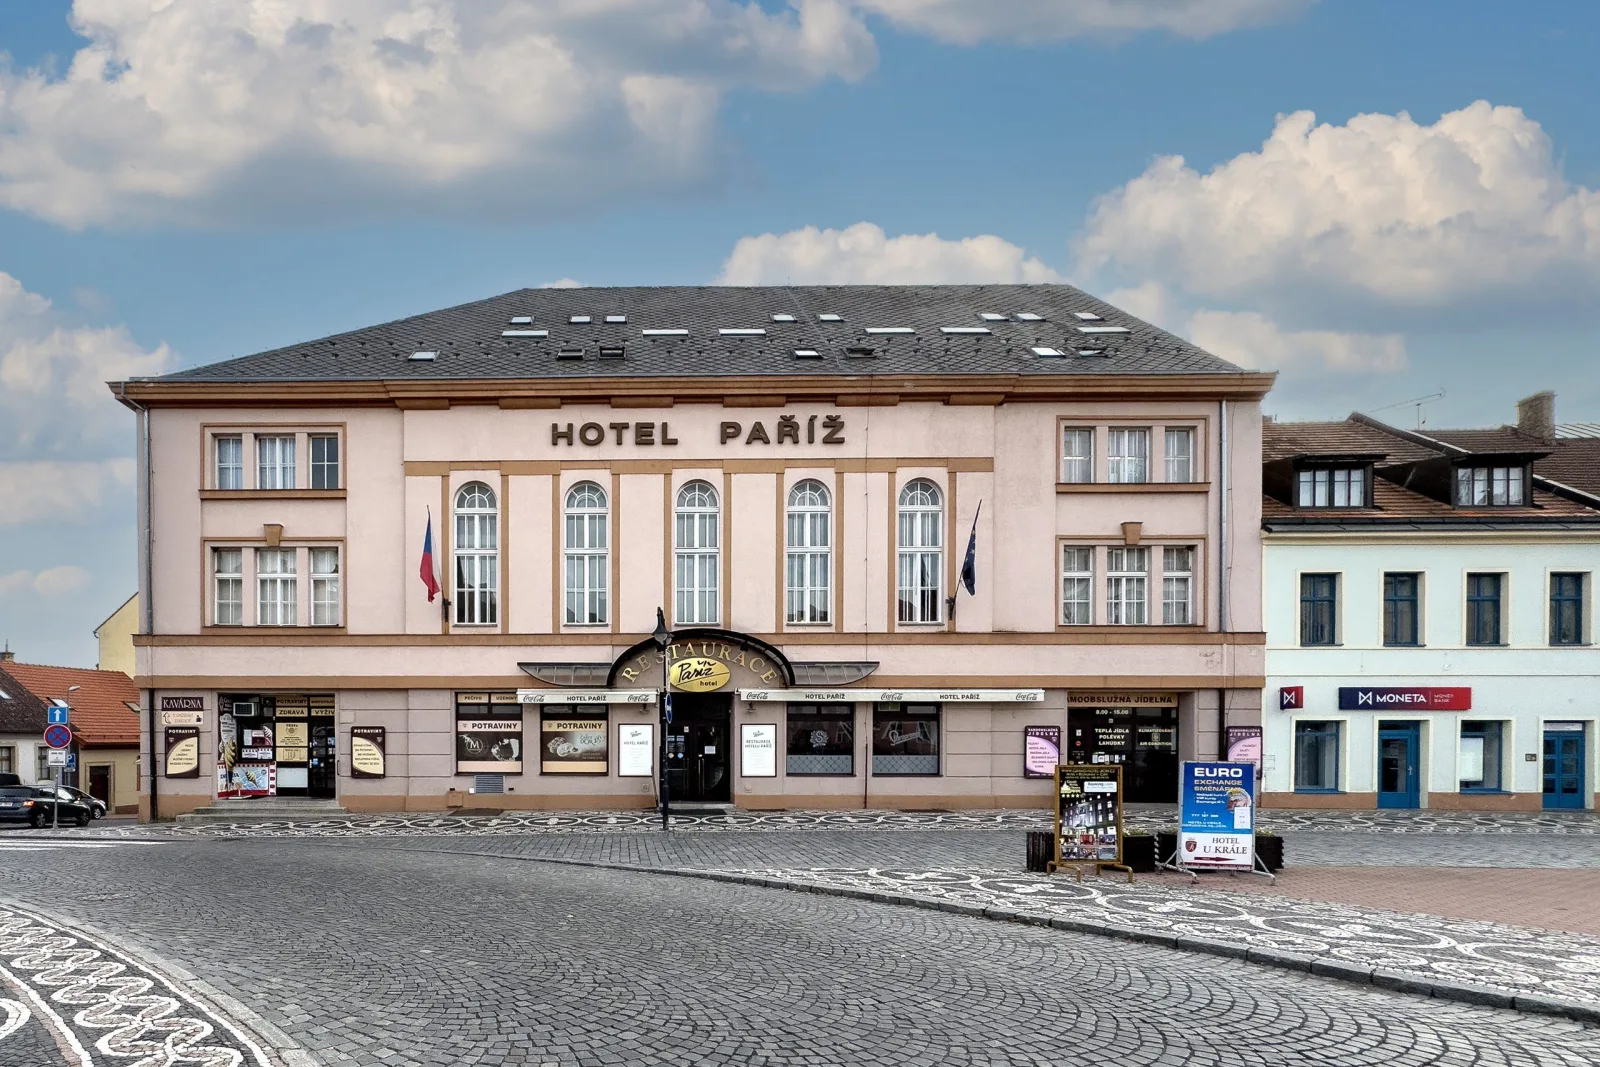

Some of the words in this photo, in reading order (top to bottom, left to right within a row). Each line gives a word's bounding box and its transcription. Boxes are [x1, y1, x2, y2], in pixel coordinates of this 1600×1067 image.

[552, 422, 678, 446] HOTEL
[720, 414, 846, 445] PAŘÍŽ
[621, 641, 778, 684] RESTAURACE
[700, 681, 718, 691] hotel
[163, 697, 202, 709] KAVÁRNA
[588, 694, 607, 702] PAŘÍŽ
[1134, 693, 1172, 703] JÍDELNA
[1376, 694, 1427, 703] MONETA
[471, 722, 518, 730] POTRAVINY
[556, 722, 603, 730] POTRAVINY
[1194, 767, 1243, 778] EURO
[1212, 837, 1240, 845] HOTEL
[1203, 845, 1212, 854] U
[1214, 844, 1248, 855] KRÁLE
